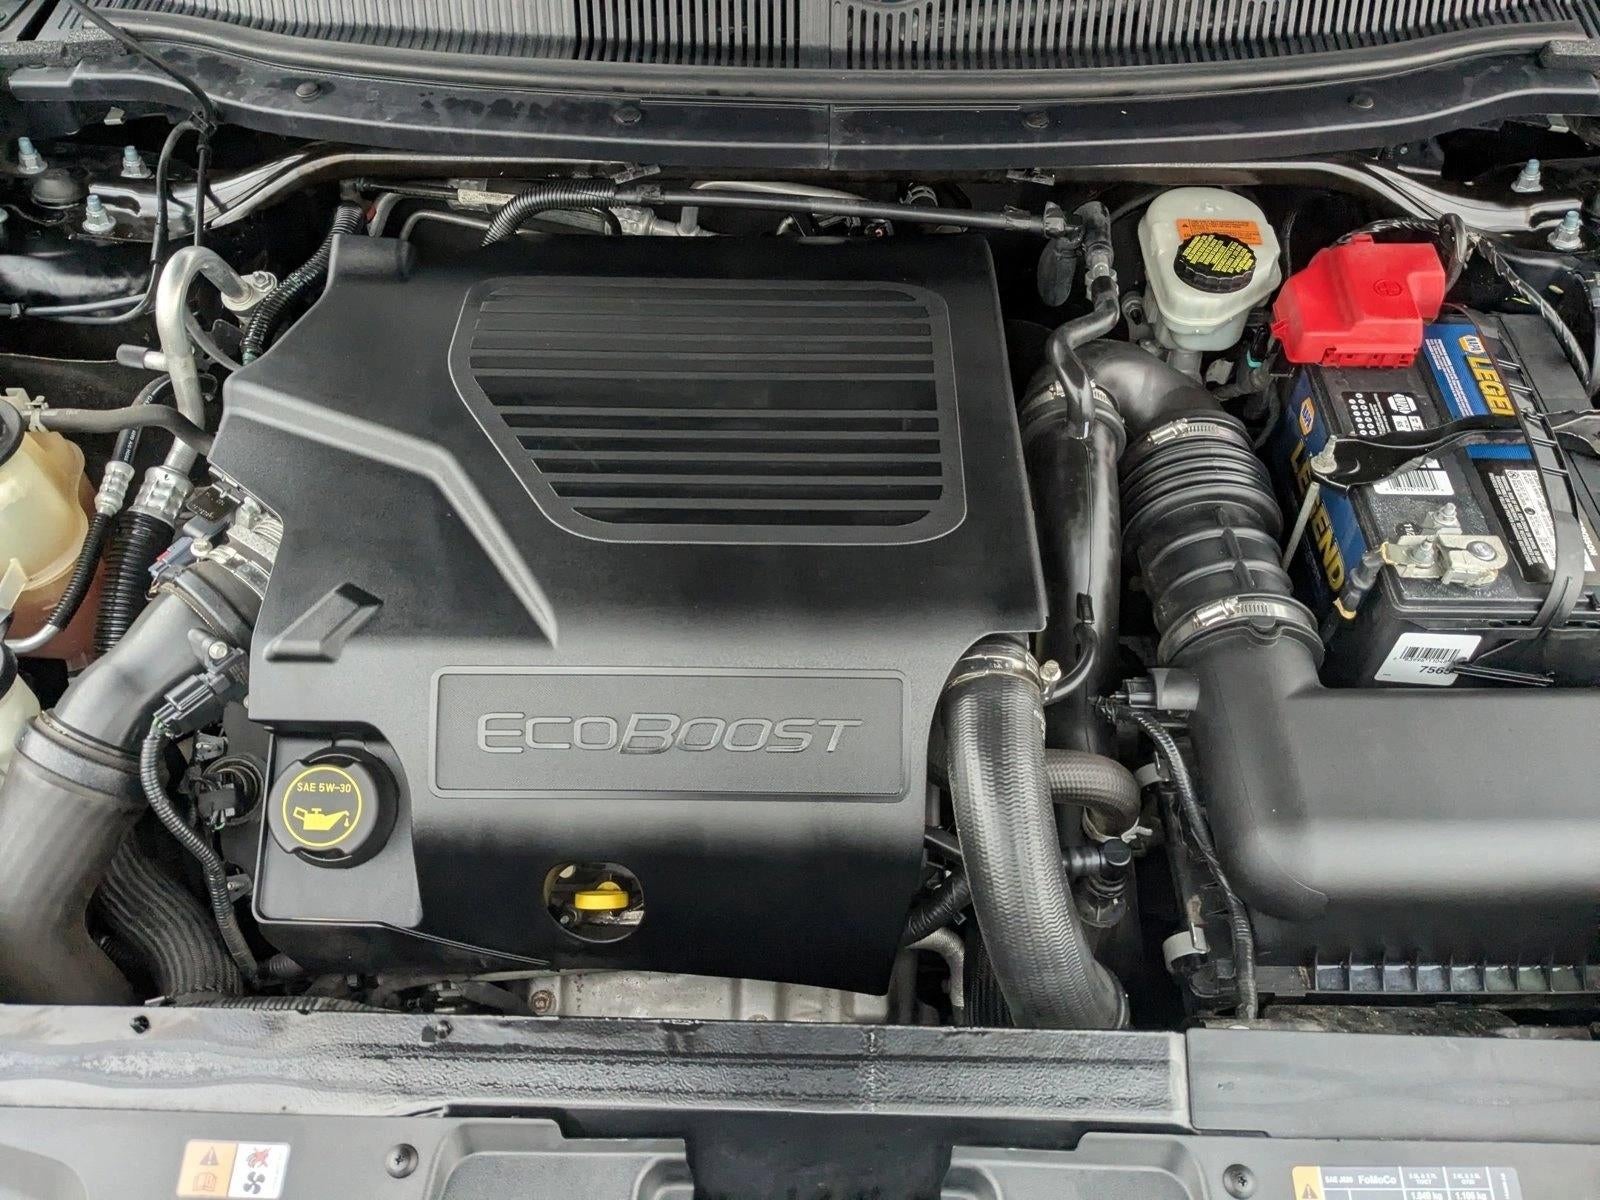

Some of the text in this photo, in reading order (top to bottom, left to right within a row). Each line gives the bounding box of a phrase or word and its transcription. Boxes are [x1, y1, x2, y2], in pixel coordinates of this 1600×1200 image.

[296, 781, 352, 793] SAE 5W-30
[1357, 1175, 1397, 1185] FoMoCo
